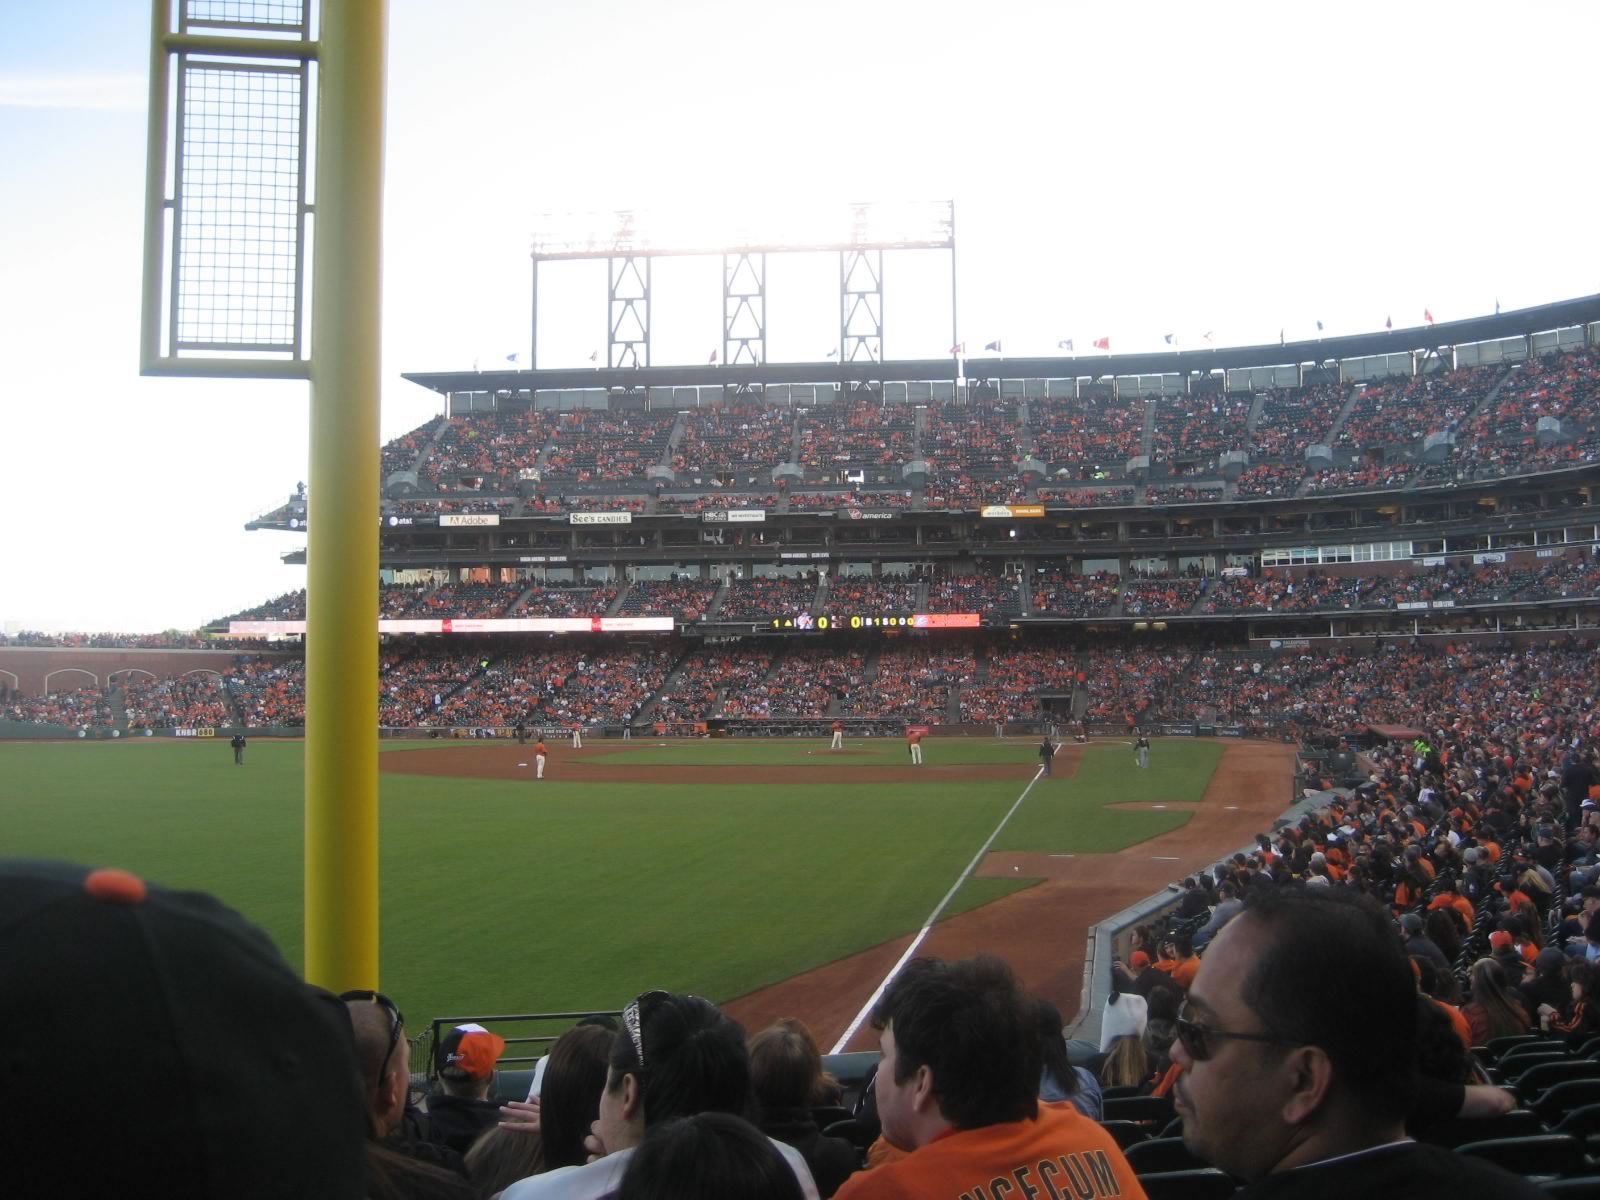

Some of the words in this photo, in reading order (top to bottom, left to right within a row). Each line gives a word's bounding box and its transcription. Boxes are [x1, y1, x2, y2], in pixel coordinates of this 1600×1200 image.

[461, 515, 489, 525] Adobe
[572, 514, 595, 523] See's
[597, 515, 628, 523] CANDIES
[817, 616, 828, 629] 0
[850, 616, 861, 629] 0
[175, 728, 197, 737] KNBR
[198, 728, 213, 736] 680
